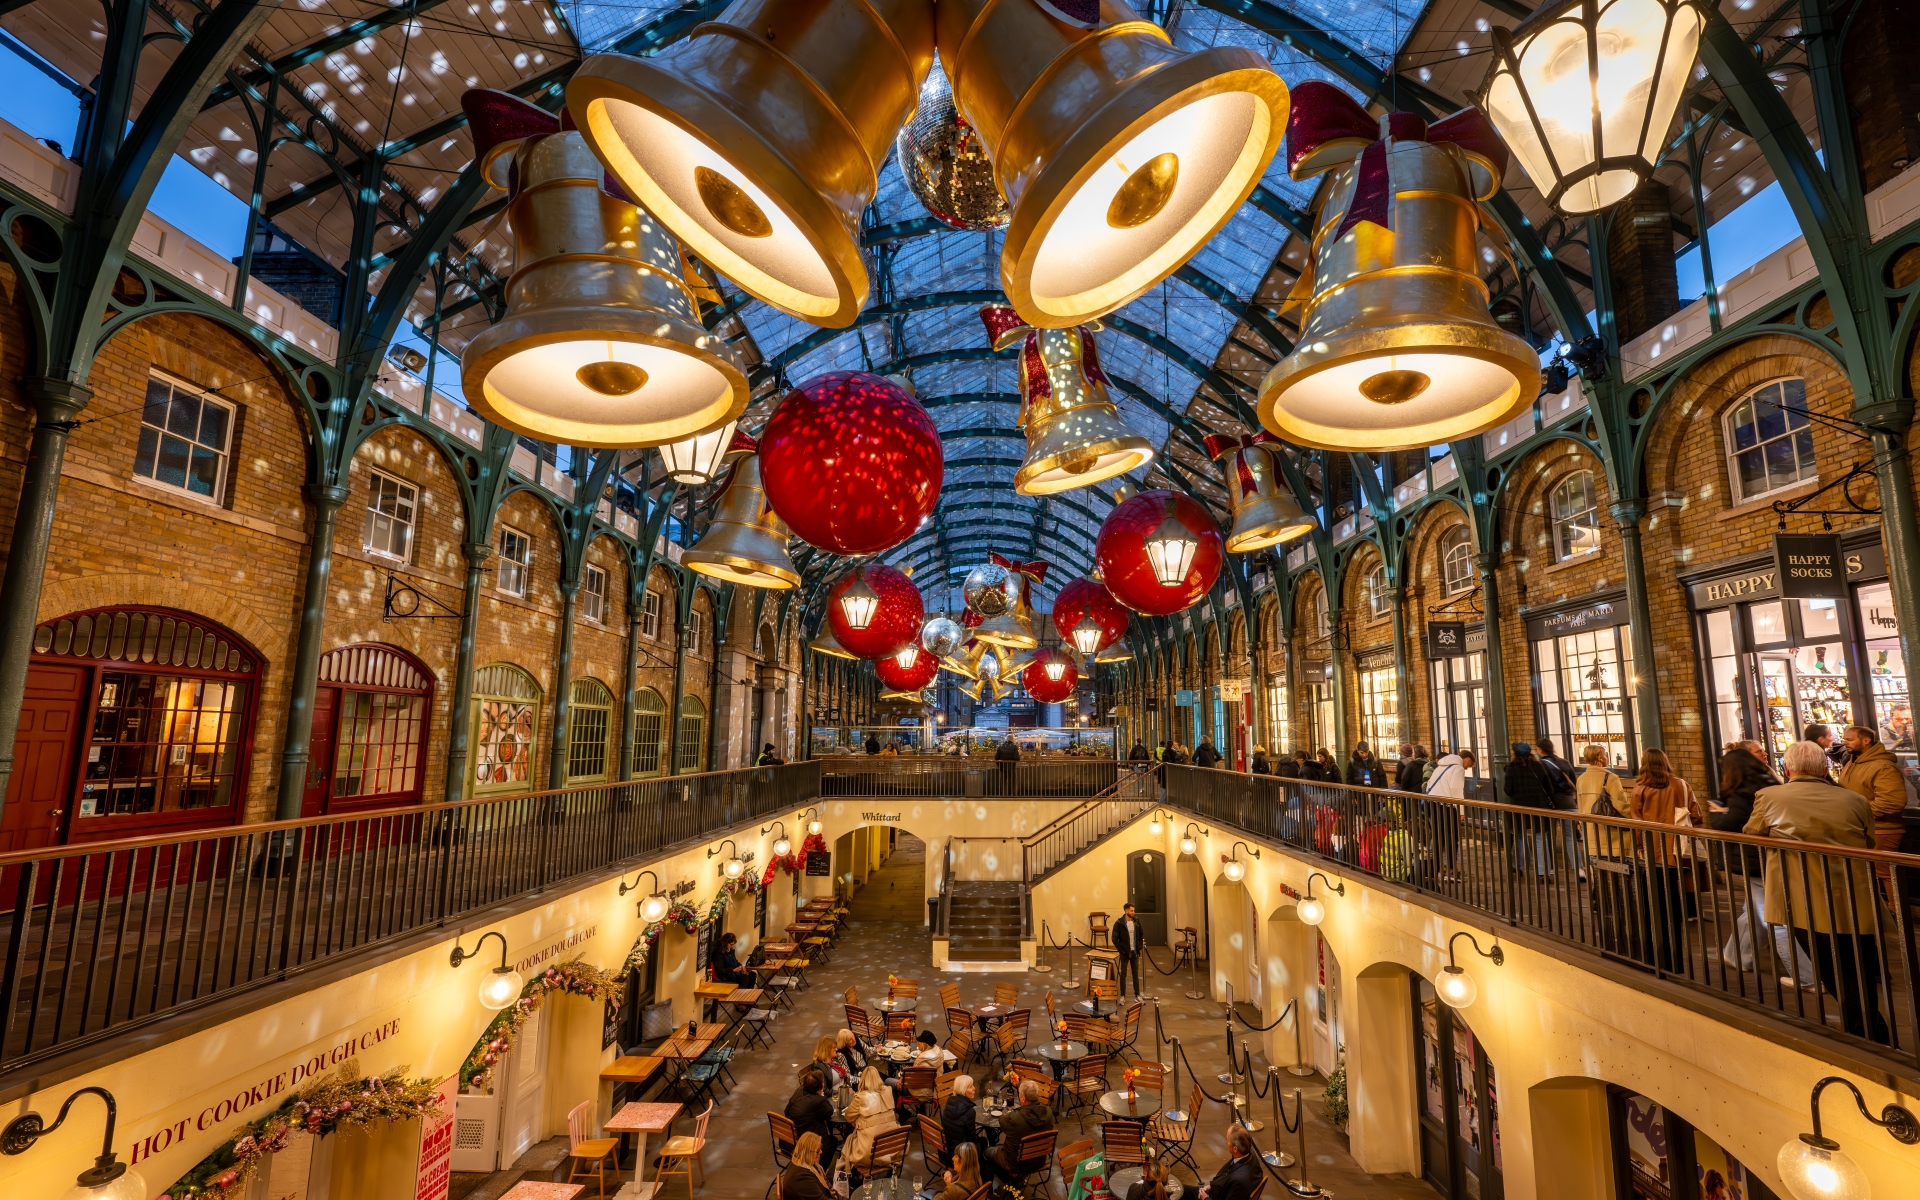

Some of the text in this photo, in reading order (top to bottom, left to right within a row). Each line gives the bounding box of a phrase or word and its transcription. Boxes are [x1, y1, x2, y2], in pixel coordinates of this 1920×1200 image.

[1789, 555, 1831, 565] HAPPY
[1790, 568, 1832, 578] SOCKS
[1706, 572, 1776, 601] HAPPY
[1544, 605, 1615, 627] PARFUMS de MARLY
[1570, 620, 1587, 628] PARIS
[1869, 607, 1896, 629] Happy
[1368, 653, 1392, 668] Venchi
[861, 812, 902, 822] Whittard
[515, 924, 598, 974] COOKIE DOUGH CAFE
[130, 1017, 400, 1166] HOT COOKIE DOUGH CAFE
[422, 1121, 453, 1154] HOT
[420, 1145, 450, 1172] SUNDAES
[416, 1171, 449, 1200] SHAKES
[417, 1157, 450, 1193] ICE CREAM
